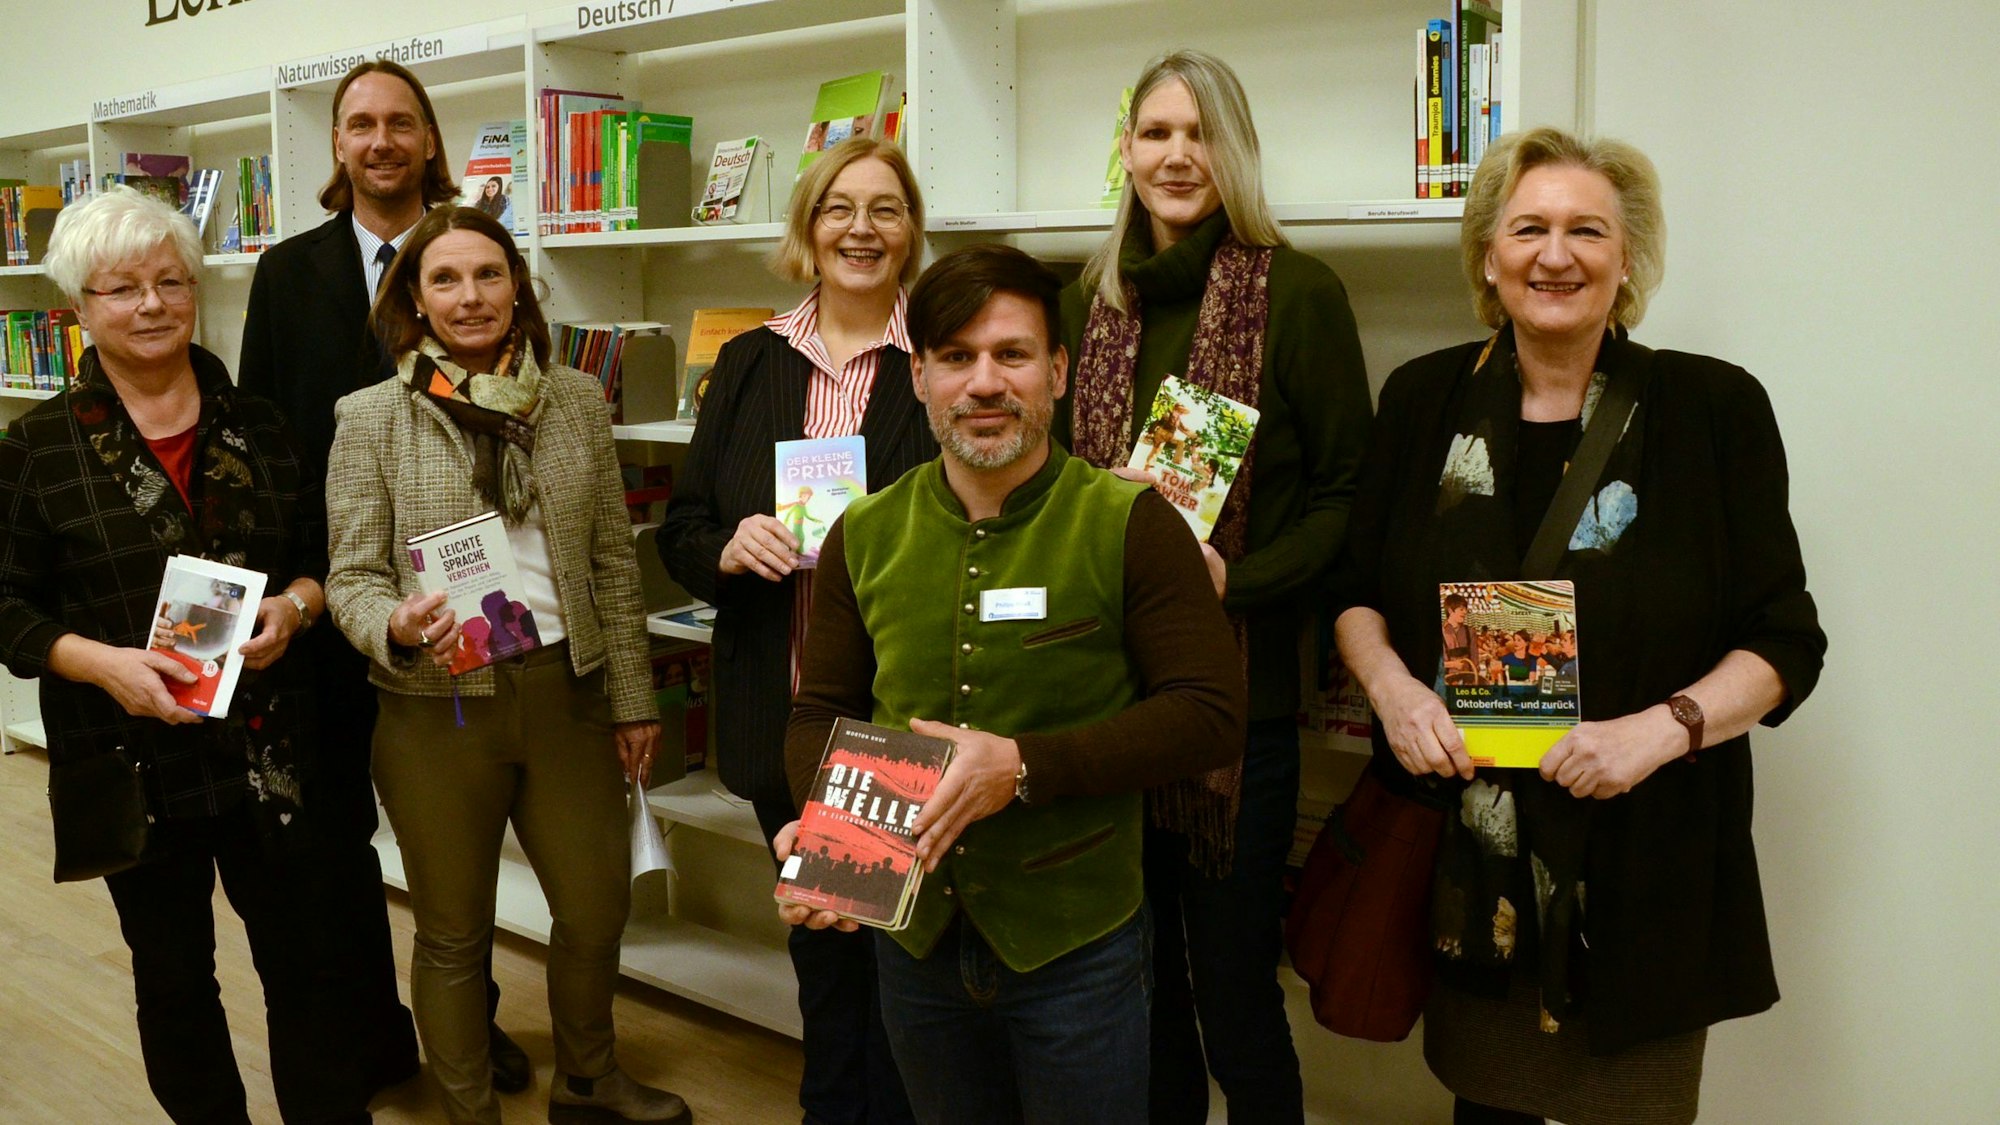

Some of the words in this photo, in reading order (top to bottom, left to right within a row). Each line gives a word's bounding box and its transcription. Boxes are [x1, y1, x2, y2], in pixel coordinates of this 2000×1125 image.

[578, 0, 661, 30] Deutsch
[1431, 56, 1439, 95] dummies
[93, 91, 157, 119] Mathematik
[1432, 102, 1441, 137] Traumjob
[714, 150, 751, 168] Deutsch
[787, 456, 808, 466] DER
[811, 451, 852, 463] KLEINE
[787, 460, 854, 481] PRINZ
[1161, 469, 1191, 493] TOM
[438, 535, 483, 559] LEICHTE
[443, 549, 487, 572] SPRACHE
[447, 562, 491, 583] VERSTEHEN
[1456, 699, 1512, 709] Oktoberfest
[1521, 700, 1540, 709] und
[1541, 699, 1575, 709] zurück
[828, 763, 874, 792] DIE
[824, 785, 921, 828] WELLE
